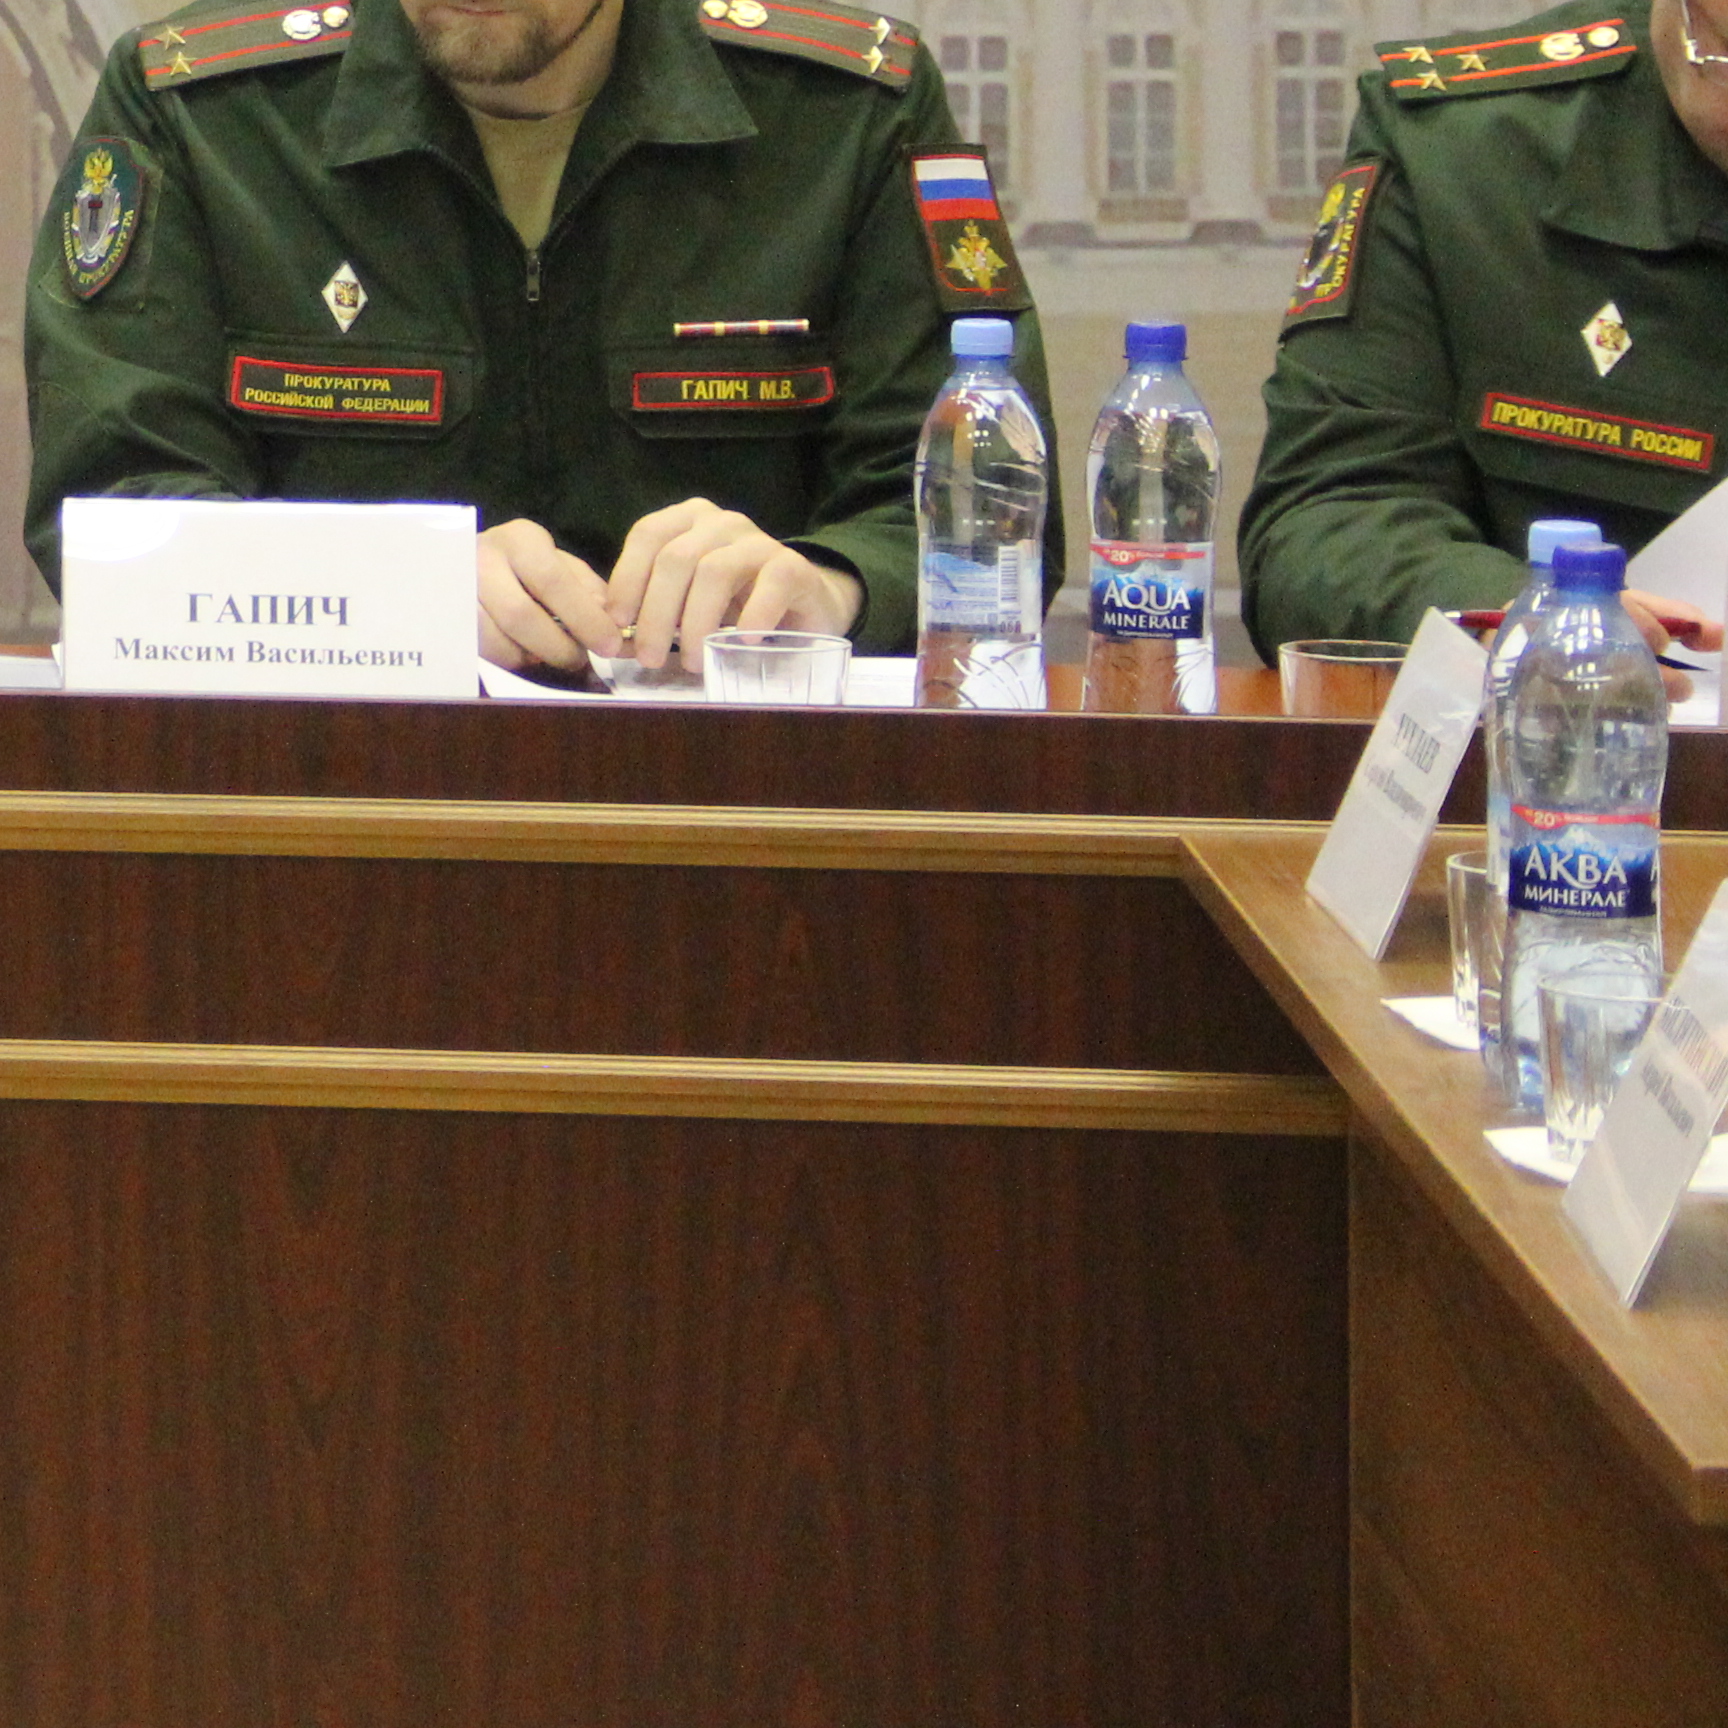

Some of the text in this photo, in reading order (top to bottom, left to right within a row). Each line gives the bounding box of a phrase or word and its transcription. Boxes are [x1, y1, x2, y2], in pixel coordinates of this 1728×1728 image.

[284, 373, 392, 392] ПРОКУРАТУРА
[681, 379, 795, 400] ГАПИЧ М.В.
[244, 387, 430, 413] РОССИЙСКОЙ ФЕДЕРАЦИИ
[1492, 402, 1704, 461] ПРОКУРАТУРА РОССИИ
[186, 592, 351, 626] ГАПИЧ
[1102, 579, 1191, 616] AQUA
[1104, 611, 1190, 629] MINERALE
[113, 637, 424, 668] Максим Васильевич
[1524, 845, 1627, 890] АКВА
[1524, 884, 1627, 908] МИНЕРАЛЕ
